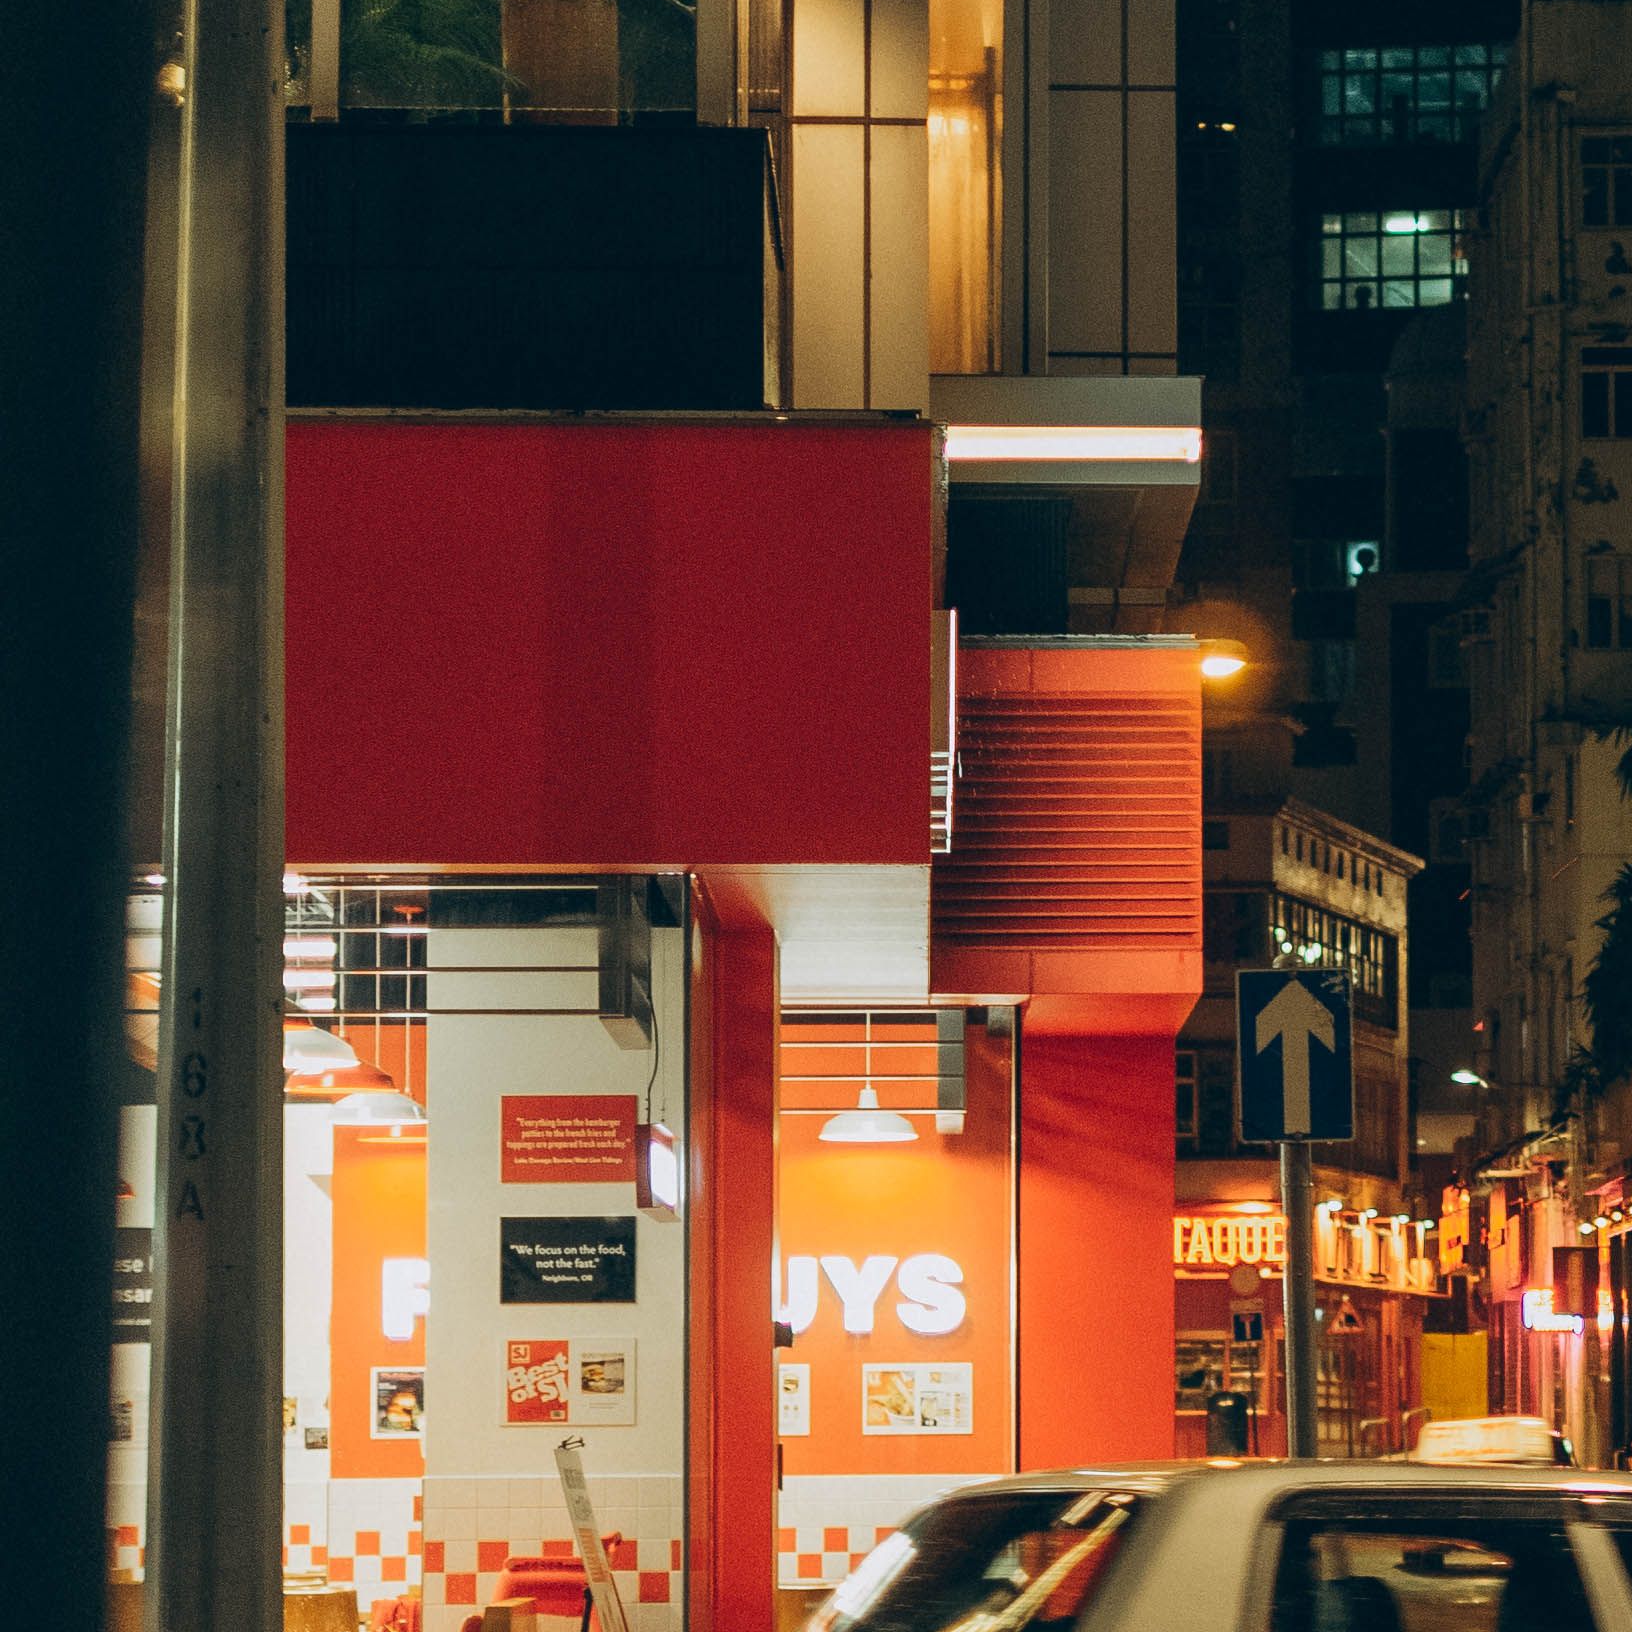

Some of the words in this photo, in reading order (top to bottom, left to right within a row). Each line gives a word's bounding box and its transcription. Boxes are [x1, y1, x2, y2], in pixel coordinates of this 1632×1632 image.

[534, 1244, 562, 1255] focus
[563, 1246, 578, 1255] on
[579, 1244, 597, 1255] the
[597, 1244, 626, 1257] food,
[536, 1258, 554, 1269] not
[555, 1257, 573, 1268] the
[507, 1352, 568, 1389] Best
